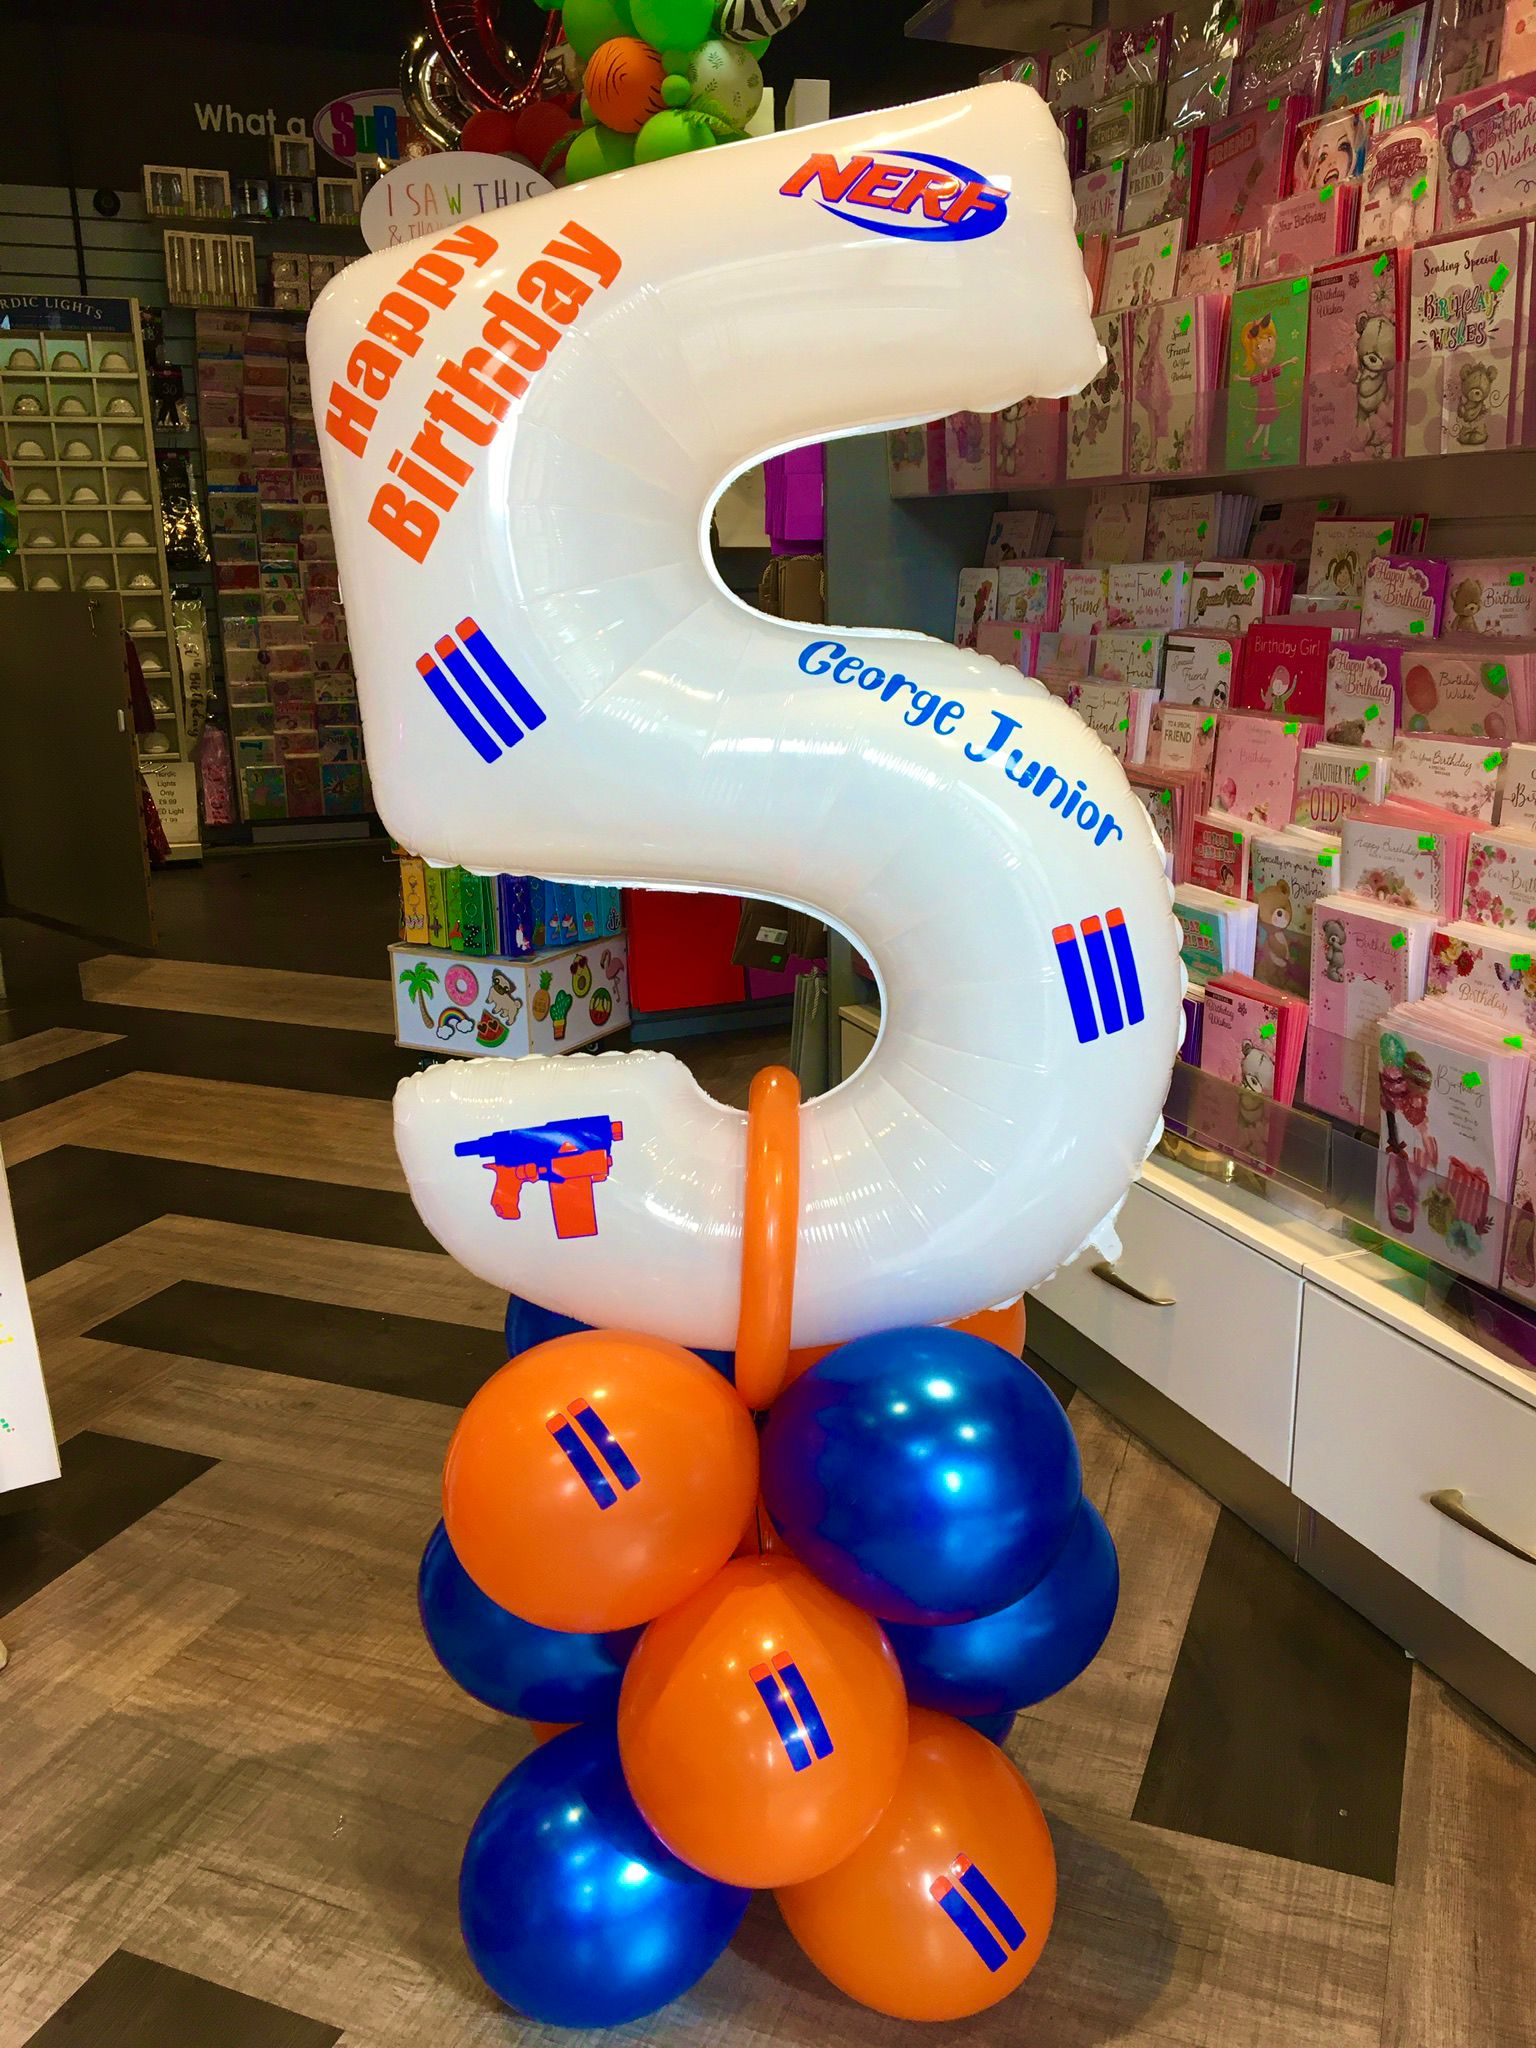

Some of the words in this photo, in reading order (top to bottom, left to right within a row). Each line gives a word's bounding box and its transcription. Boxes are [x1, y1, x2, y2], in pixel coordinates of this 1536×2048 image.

[194, 102, 277, 135] What
[286, 116, 306, 137] a
[779, 153, 1012, 224] NERF
[1129, 173, 1164, 195] FRIEND
[387, 183, 393, 216] I
[405, 183, 463, 217] SAW
[1423, 259, 1460, 277] Sending
[1464, 250, 1500, 272] Special
[45, 296, 103, 320] LIGHTS
[1313, 289, 1345, 304] Birthday
[1316, 304, 1344, 318] Wishes
[325, 224, 499, 459] Happy
[1166, 343, 1191, 358] Friend
[162, 383, 177, 395] 30
[1171, 373, 1192, 383] Birthday
[367, 220, 622, 564] Birthday
[1376, 561, 1406, 588] Happy
[1070, 597, 1101, 622] Friend
[1383, 583, 1433, 616] Birthday
[1484, 587, 1532, 611] Birthday
[1254, 636, 1297, 658] Birthday
[1300, 638, 1321, 656] Girl
[1182, 667, 1209, 682] Friend
[1336, 653, 1365, 676] Happy
[1345, 674, 1394, 704] Birthday
[1439, 672, 1480, 688] Birthday
[1446, 689, 1475, 701] Wishes
[1086, 704, 1119, 734] Friend
[798, 641, 965, 735] George
[964, 710, 1122, 846] Junior
[1164, 730, 1192, 743] FRIEND
[156, 770, 177, 778] Nordic
[1312, 762, 1342, 784] ANOTHER
[1344, 766, 1360, 786] YEA
[1432, 750, 1473, 776] Birthday
[157, 780, 177, 788] Lights
[160, 789, 175, 798] Only
[168, 806, 184, 816] Light
[1256, 850, 1283, 870] Especially
[1353, 838, 1380, 854] Happy
[1382, 837, 1420, 860] Birthday
[1354, 936, 1399, 963] Birthday
[1206, 999, 1234, 1022] Birthday
[1458, 983, 1508, 1017] Birthday
[1208, 1013, 1232, 1030] Wishes
